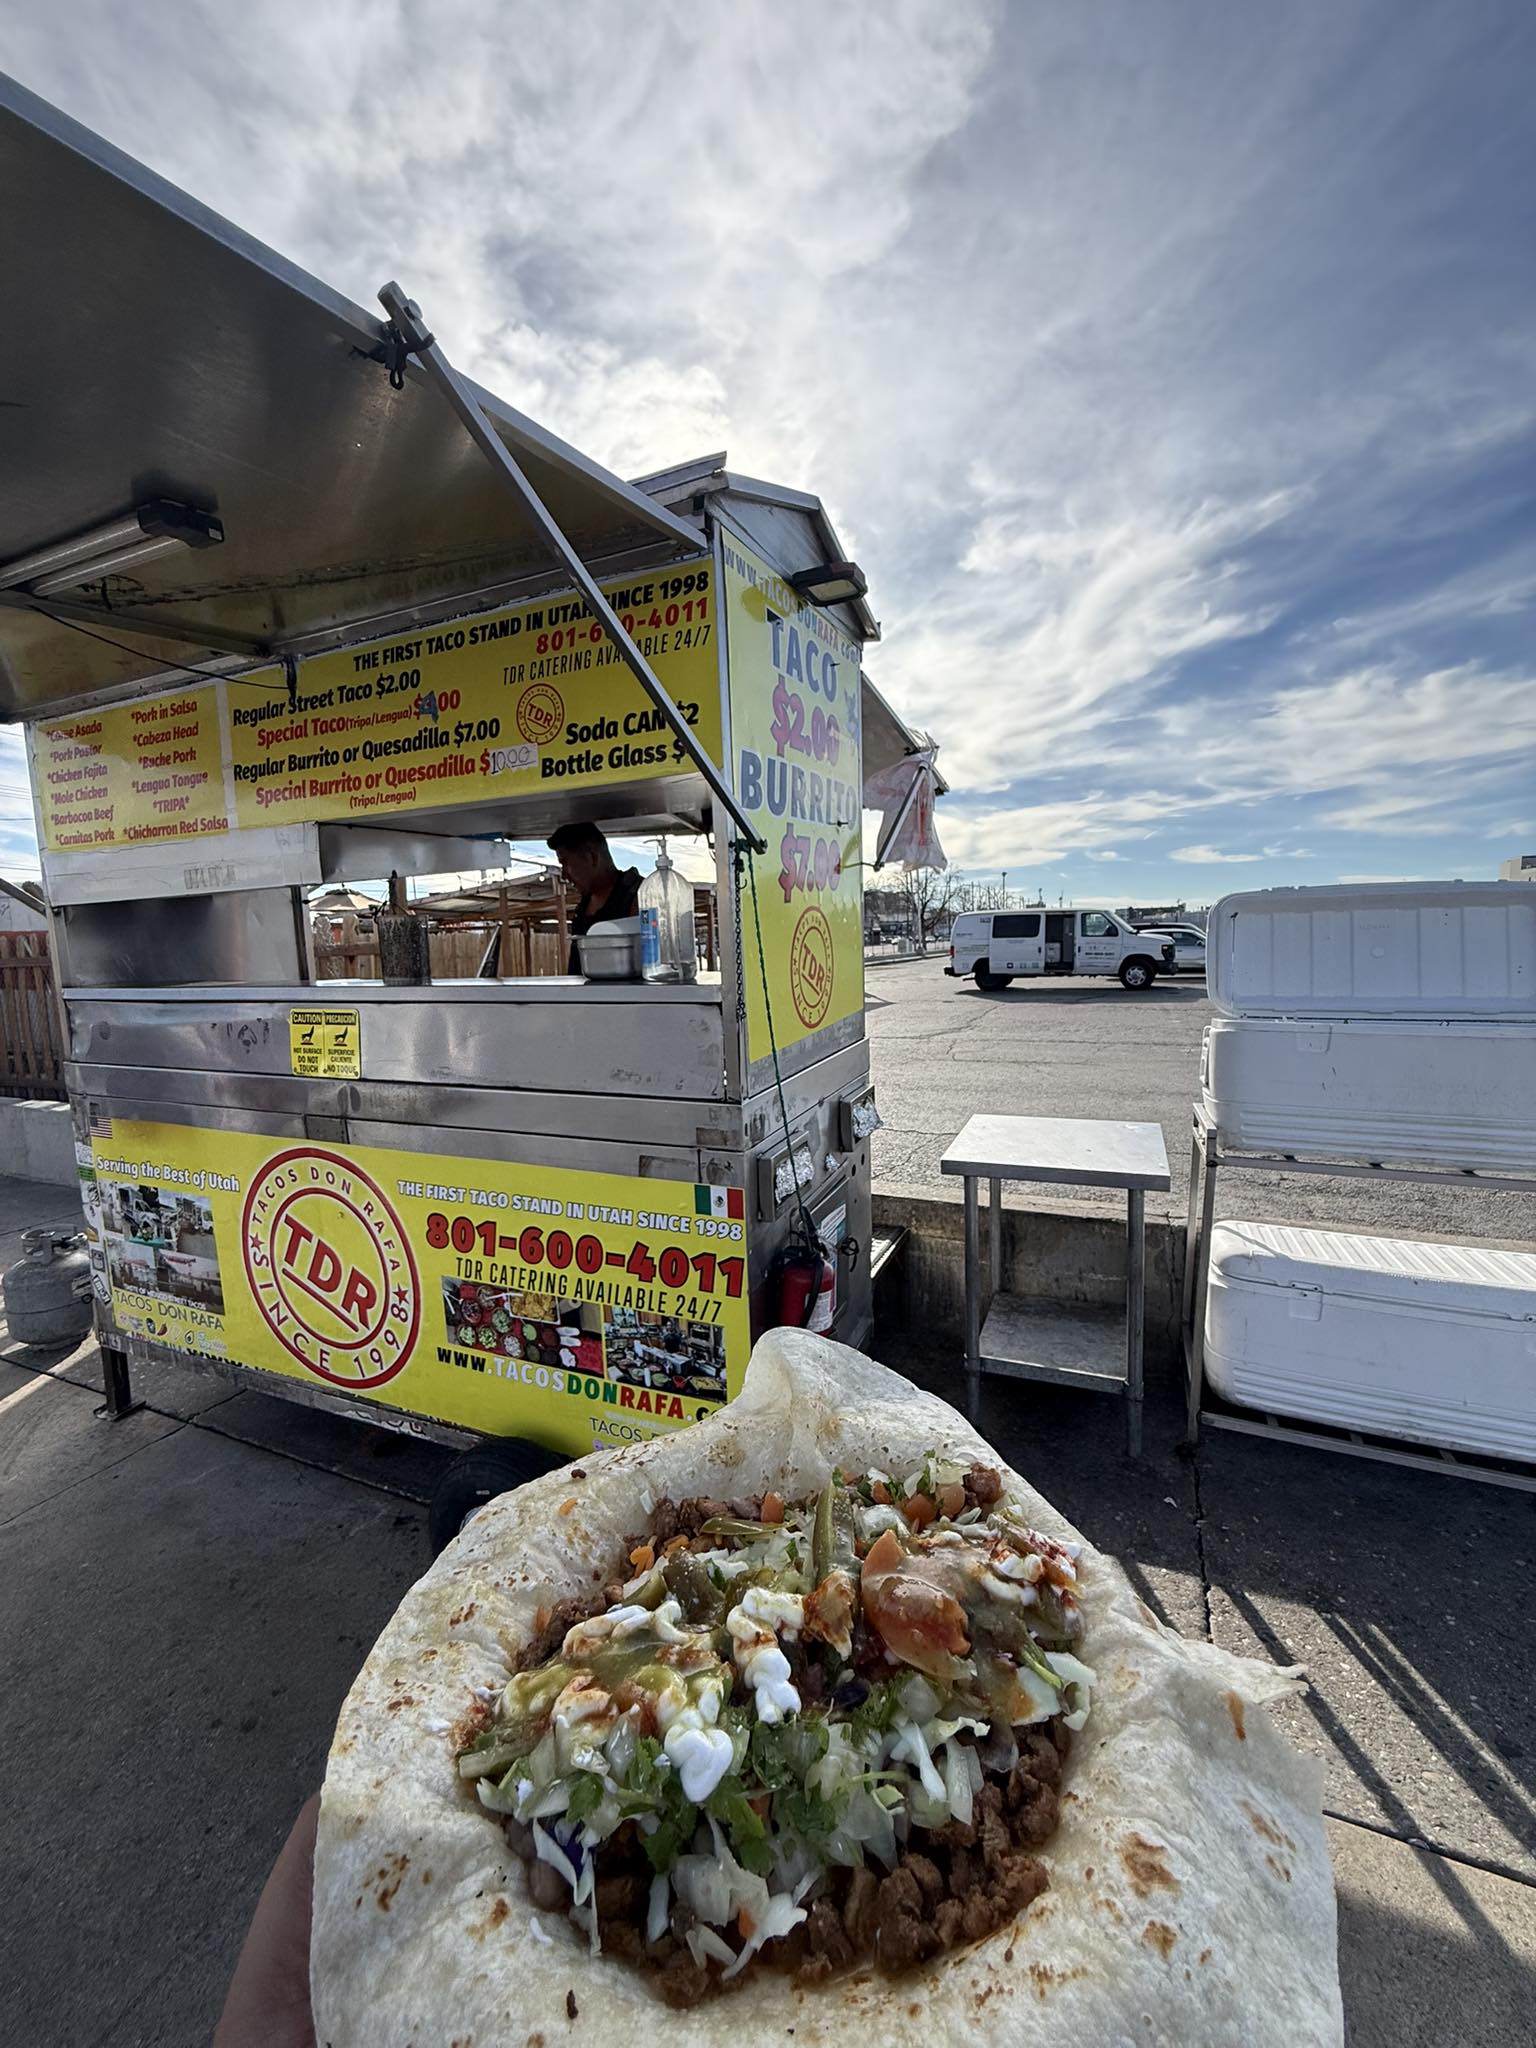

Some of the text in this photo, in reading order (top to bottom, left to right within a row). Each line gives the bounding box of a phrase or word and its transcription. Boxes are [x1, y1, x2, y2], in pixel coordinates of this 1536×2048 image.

[353, 654, 379, 672] THE
[382, 641, 423, 666] FIRST
[427, 630, 466, 656] TACO
[469, 618, 521, 645] STAND
[526, 611, 544, 632] IN
[659, 571, 709, 600] 1998
[536, 597, 708, 655] 801-60-4011
[503, 661, 525, 686] TDR
[530, 649, 592, 680] CATERING
[674, 624, 711, 651] 24/7
[767, 608, 838, 702] TACO
[159, 704, 168, 719] in
[170, 700, 197, 716] Salsa
[233, 669, 421, 727] Regular Street Taco $2.00
[527, 702, 554, 728] TDR
[75, 720, 102, 737] Asada
[173, 723, 199, 739] Head
[257, 718, 308, 750] Special
[565, 716, 619, 745] Soda
[623, 708, 667, 736] CAN
[74, 744, 102, 758] Pastor
[173, 747, 196, 764] Pork
[234, 755, 286, 782] Regular
[288, 747, 340, 772] Burrito
[343, 746, 360, 764] or
[362, 726, 450, 761] Quesadilla
[454, 717, 500, 748] $7.00
[541, 750, 603, 778] Bottle
[608, 744, 667, 769] Glass
[83, 764, 108, 780] Fajita
[172, 771, 208, 788] Tongue
[255, 777, 307, 807] Special
[309, 771, 361, 797] Burrito
[365, 772, 382, 789] or
[384, 754, 476, 787] Quesadilla
[75, 786, 108, 800] Chicken
[349, 787, 417, 810] (Tripa/Lengua)
[741, 749, 857, 830] BURRITO
[95, 805, 114, 821] Beef
[180, 820, 198, 834] Red
[200, 816, 229, 832] Salsa
[95, 828, 115, 842] Pork
[778, 822, 841, 904] $7.00
[803, 943, 825, 992] TDR
[294, 1013, 321, 1023] CAUTION
[299, 1064, 319, 1073] TOUCH
[307, 1056, 318, 1064] NOT
[327, 1065, 336, 1073] NO
[97, 1156, 241, 1192] Serving the Best of Utah
[252, 1166, 401, 1272] TACOS DON RAFA
[398, 1180, 744, 1241] THE FIRST TACO STAND IN UTAH SINCE 1998
[284, 1213, 377, 1331] TDR
[426, 1212, 746, 1299] 801-600-4011
[455, 1257, 723, 1323] TDR CATERING AVAILABLE 24/7
[114, 1290, 153, 1312] TACOS
[158, 1302, 188, 1322] DON
[191, 1310, 225, 1332] RAFA
[253, 1252, 331, 1372] SINCE
[352, 1303, 410, 1378] 1998
[589, 1417, 643, 1442] TACOS
